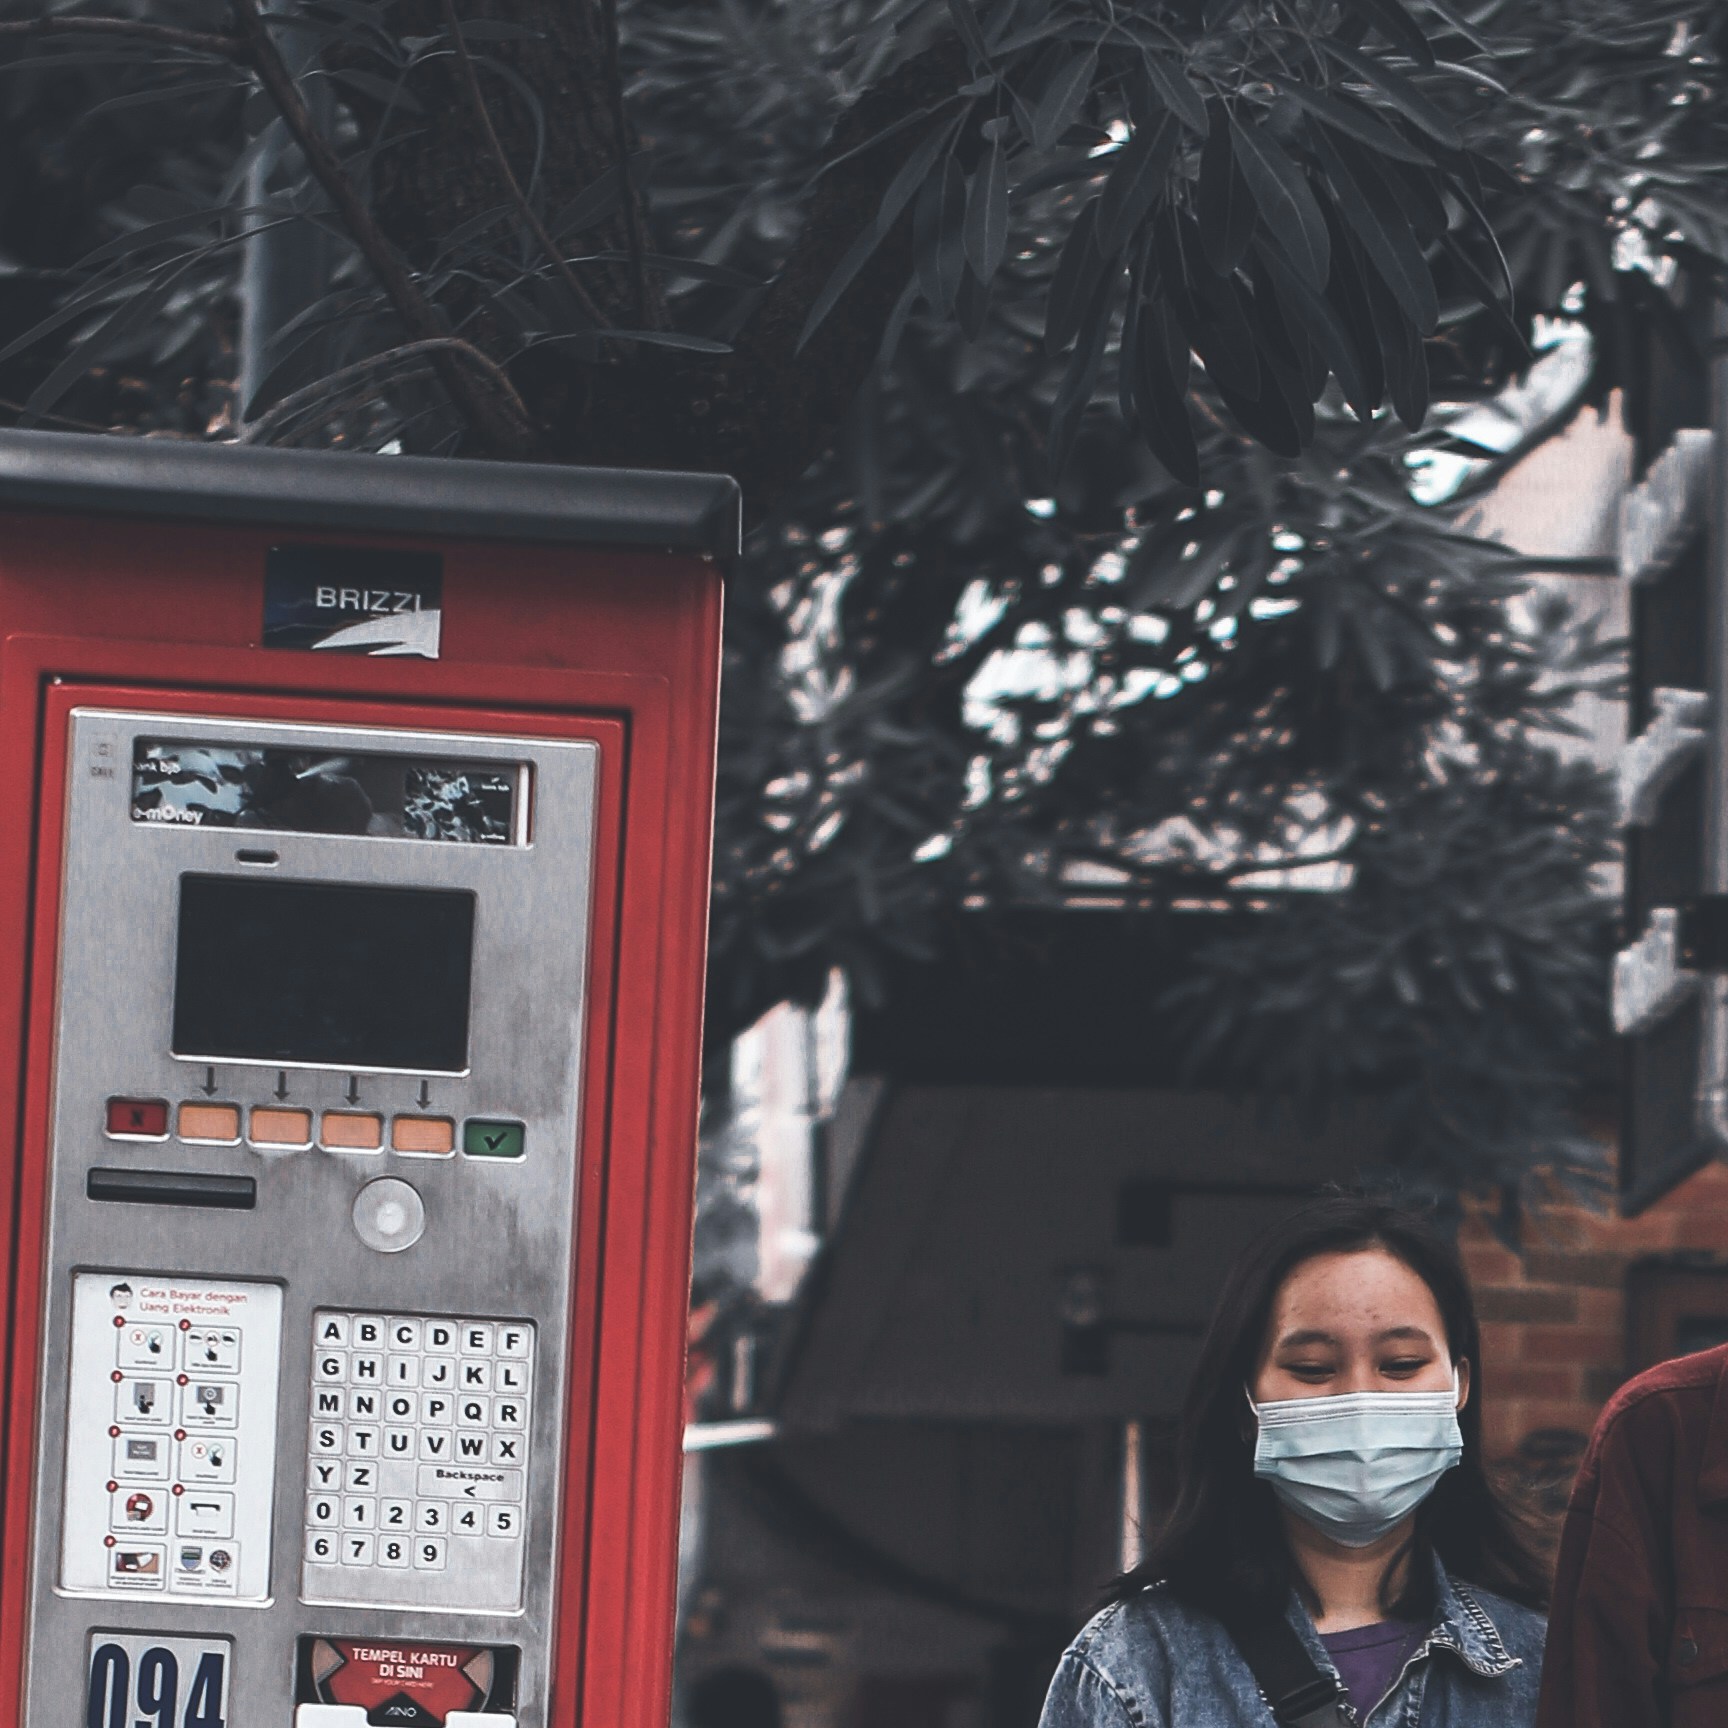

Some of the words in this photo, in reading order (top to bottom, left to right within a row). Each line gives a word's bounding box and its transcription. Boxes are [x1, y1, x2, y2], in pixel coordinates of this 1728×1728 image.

[316, 586, 421, 613] BRIZZI
[141, 1288, 166, 1298] Cara
[170, 1290, 201, 1301] Bayar
[205, 1292, 248, 1303] dengan
[140, 1302, 169, 1313] Uang
[173, 1304, 230, 1315] Elektronik
[324, 1322, 340, 1340] A
[361, 1324, 377, 1342] B
[396, 1326, 412, 1344] C
[433, 1328, 449, 1346] D
[469, 1330, 484, 1348] E
[506, 1333, 520, 1350] F
[322, 1358, 339, 1376] G
[358, 1360, 375, 1378] H
[432, 1365, 446, 1382] J
[466, 1366, 483, 1384] K
[504, 1369, 518, 1386] L
[319, 1393, 339, 1412] M
[356, 1396, 374, 1414] N
[429, 1400, 445, 1418] P
[464, 1402, 482, 1421] Q
[501, 1404, 517, 1422] R
[319, 1430, 335, 1448] S
[355, 1432, 372, 1450] T
[391, 1434, 408, 1452] U
[427, 1436, 444, 1454] V
[460, 1438, 483, 1456] W
[499, 1440, 516, 1458] X
[317, 1465, 334, 1483] Y
[353, 1468, 370, 1486] Z
[436, 1469, 504, 1482] Backspace
[389, 1506, 403, 1524] 2
[425, 1508, 439, 1526] 3
[460, 1511, 475, 1528] 4
[497, 1512, 511, 1530] 5
[314, 1538, 329, 1556] 6
[351, 1540, 365, 1558] 7
[387, 1542, 401, 1560] 8
[423, 1544, 437, 1562] 9
[352, 1648, 406, 1663] TEMPEL
[410, 1652, 458, 1667] KARTU
[379, 1664, 394, 1677] DI
[396, 1666, 423, 1679] SINI
